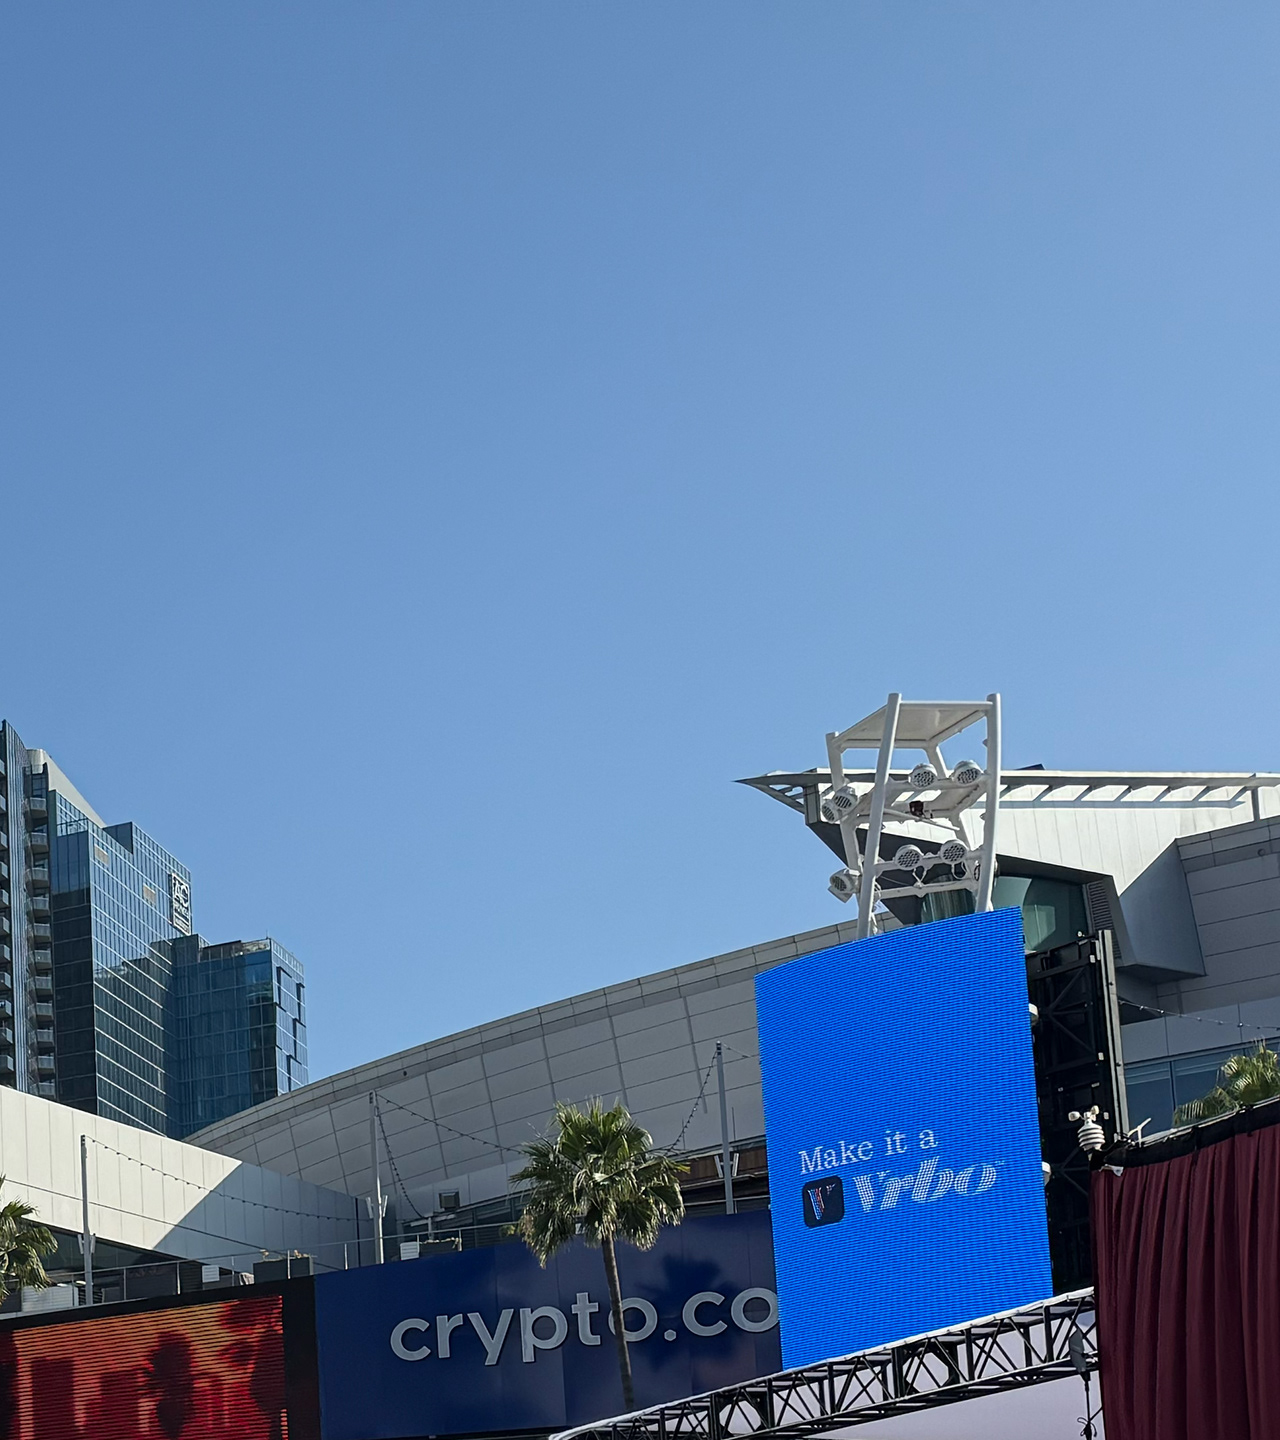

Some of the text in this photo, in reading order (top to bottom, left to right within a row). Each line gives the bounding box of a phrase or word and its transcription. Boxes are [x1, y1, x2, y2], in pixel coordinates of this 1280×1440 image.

[798, 1128, 939, 1175] Make it a
[852, 1155, 998, 1213] Vrbo
